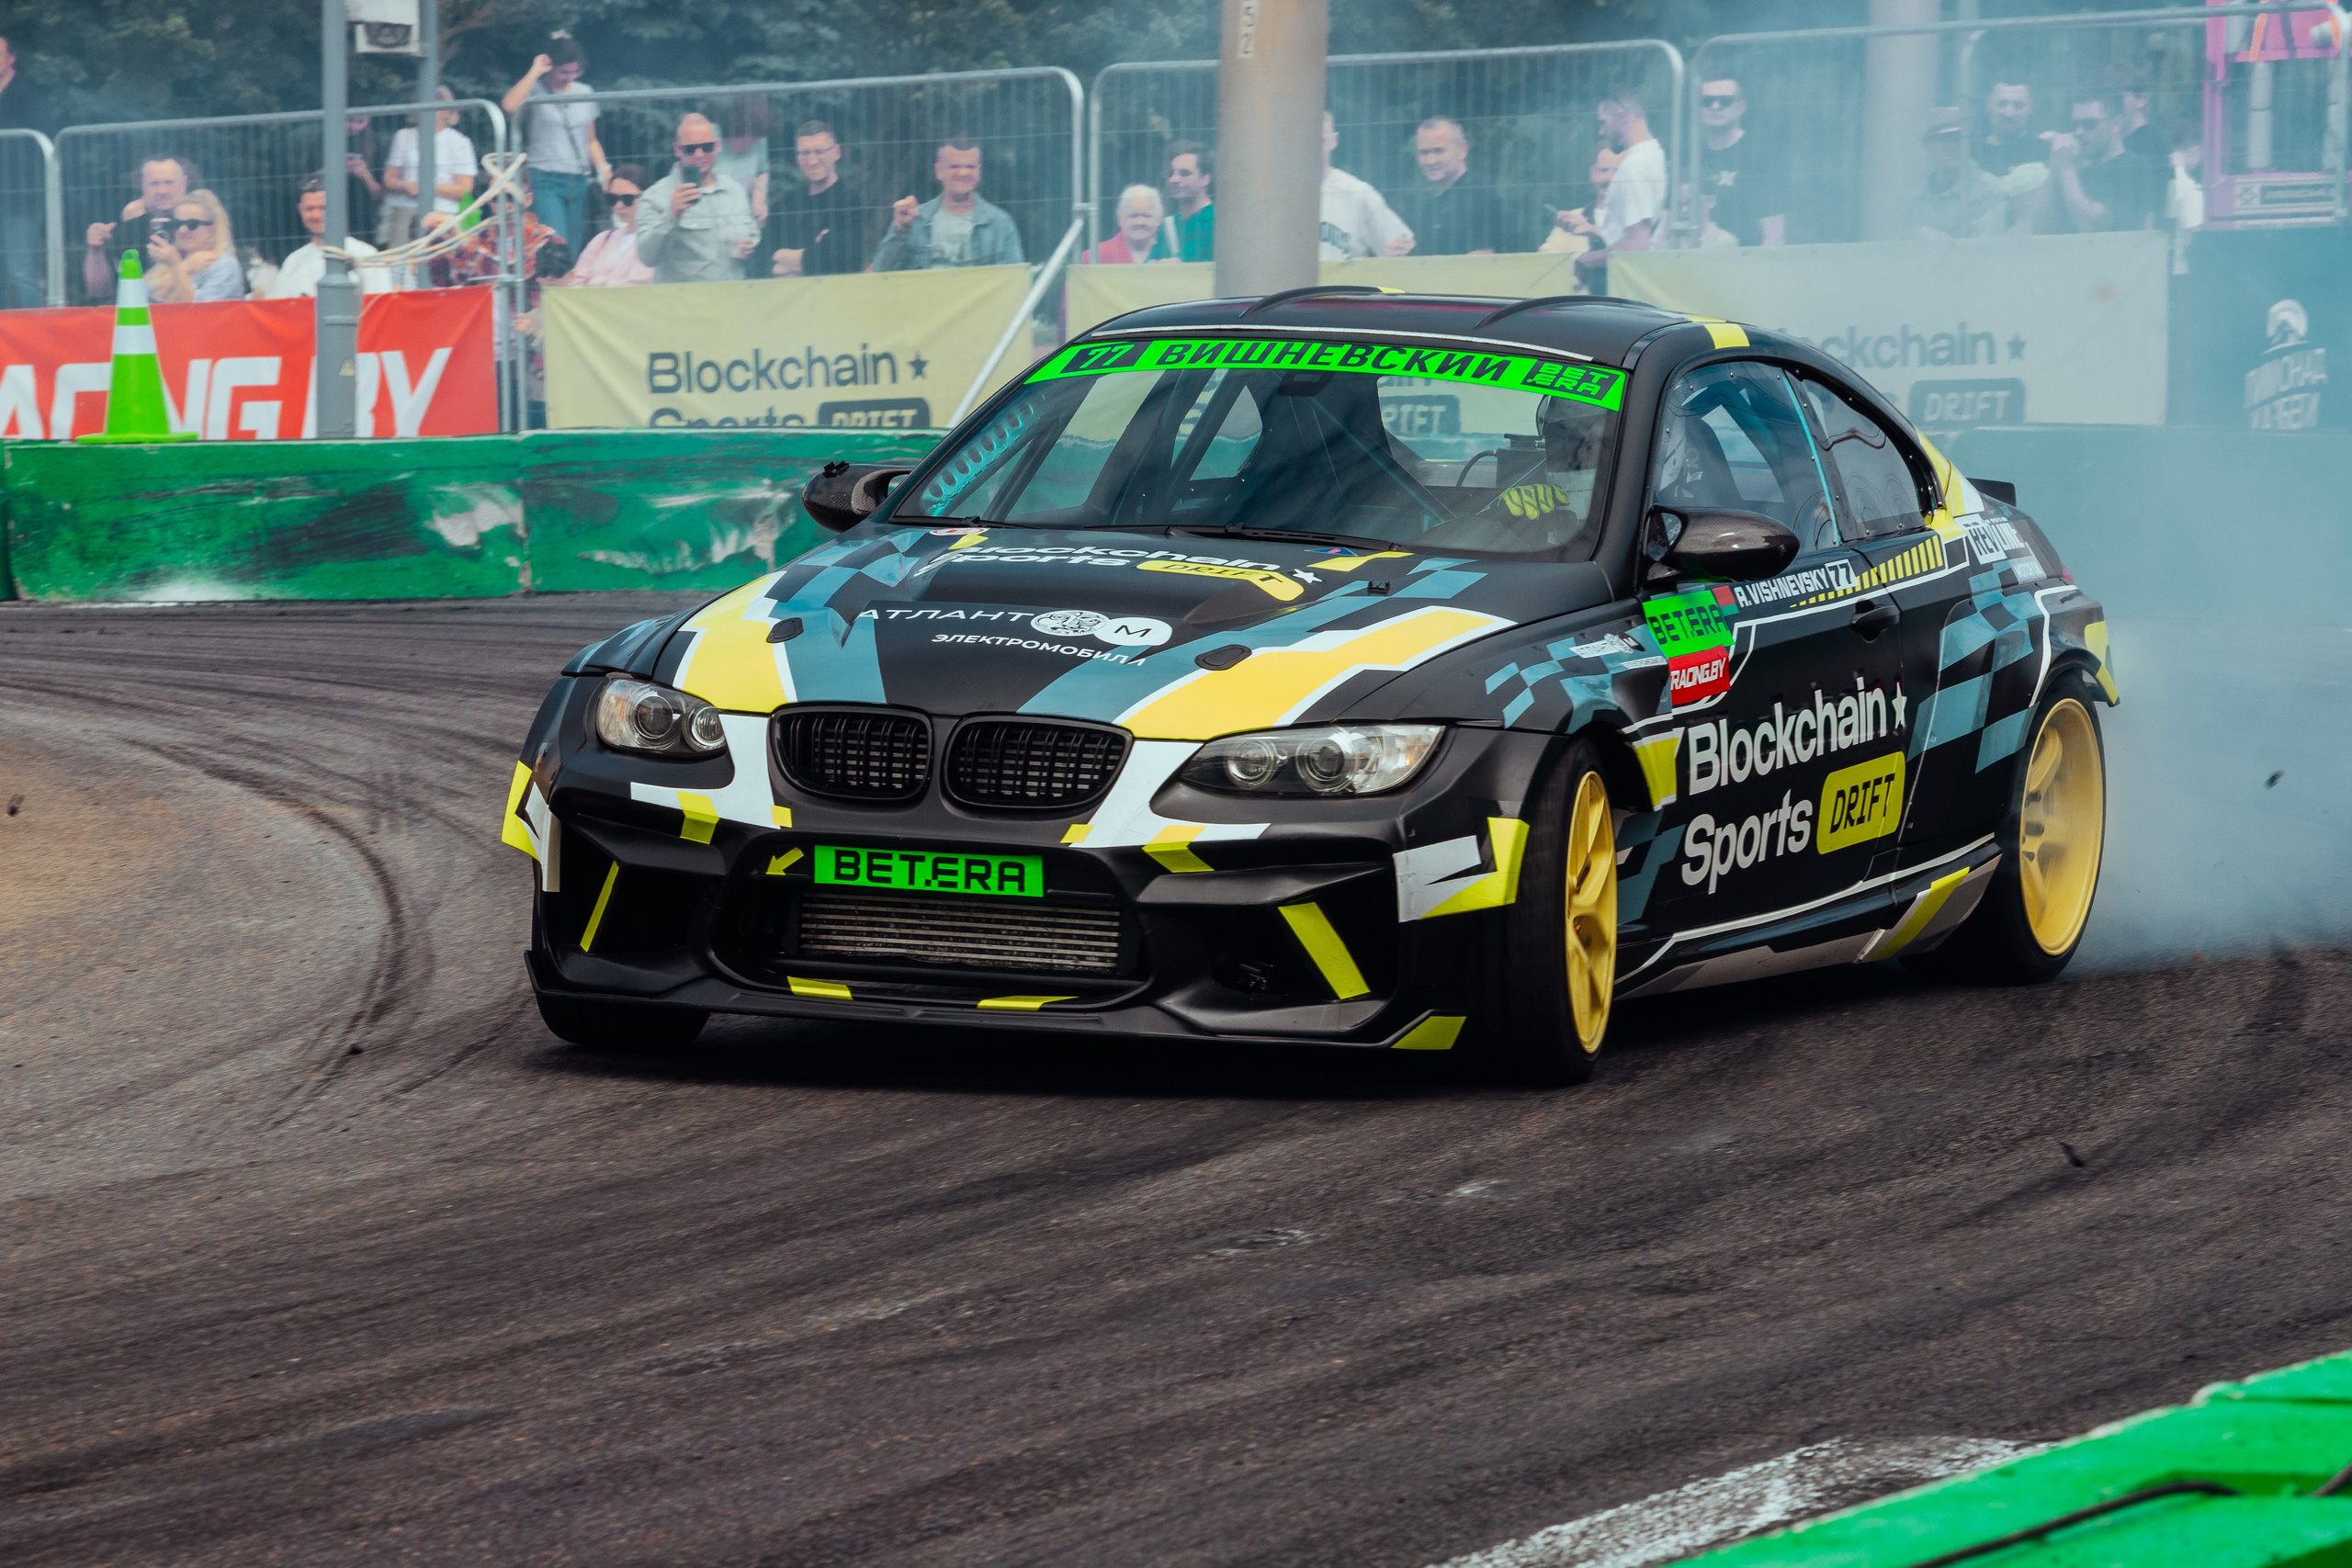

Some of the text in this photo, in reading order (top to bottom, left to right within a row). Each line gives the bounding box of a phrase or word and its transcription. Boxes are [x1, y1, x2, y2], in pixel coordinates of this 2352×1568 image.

[648, 343, 899, 394] Blockchain
[1079, 344, 1136, 368] 77
[1539, 362, 1610, 384] BET
[1924, 389, 2010, 423] DRIFT
[1828, 562, 1854, 590] 77
[858, 609, 1035, 622] АТЛАНТ
[1688, 676, 1887, 796] Blockchain
[1681, 773, 1895, 895] Sports DRIFT
